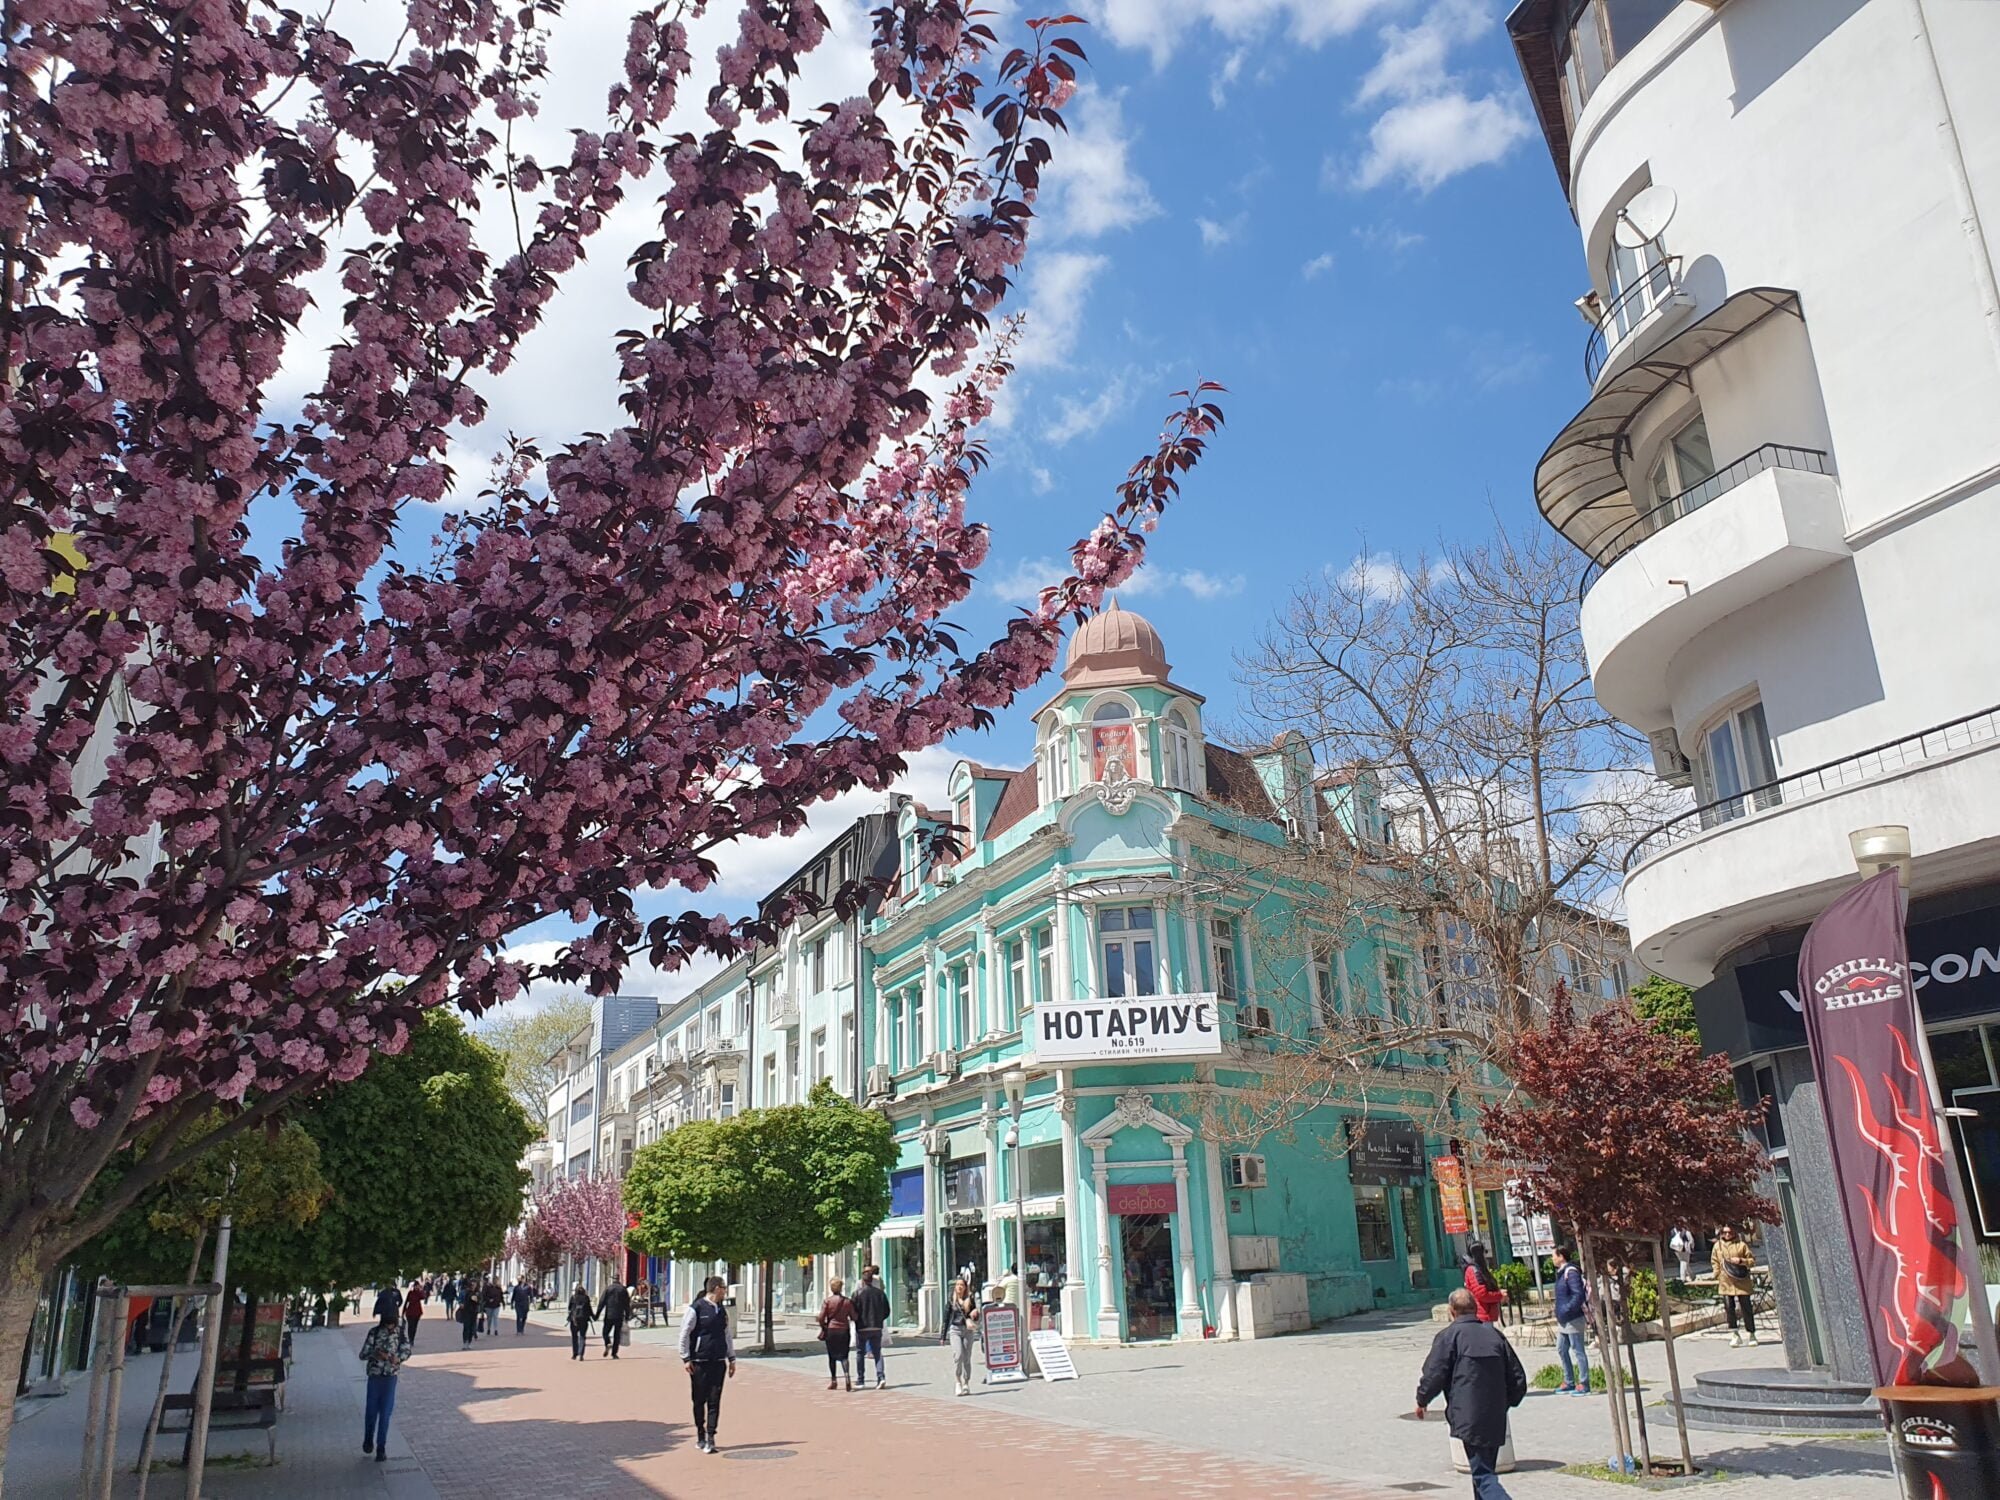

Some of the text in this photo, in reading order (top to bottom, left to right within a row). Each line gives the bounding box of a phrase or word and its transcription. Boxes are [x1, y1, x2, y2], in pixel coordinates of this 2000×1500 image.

[1100, 730, 1127, 740] English
[1097, 743, 1128, 753] Orange
[1814, 958, 1907, 994] CHILLI
[1824, 984, 1904, 1011] HILLS
[1043, 1003, 1213, 1041] НОТАРИУС
[1111, 1037, 1145, 1048] No.619
[1118, 1195, 1166, 1214] delpho
[1901, 1416, 1956, 1435] CHILLI
[1904, 1433, 1954, 1446] HILLS
